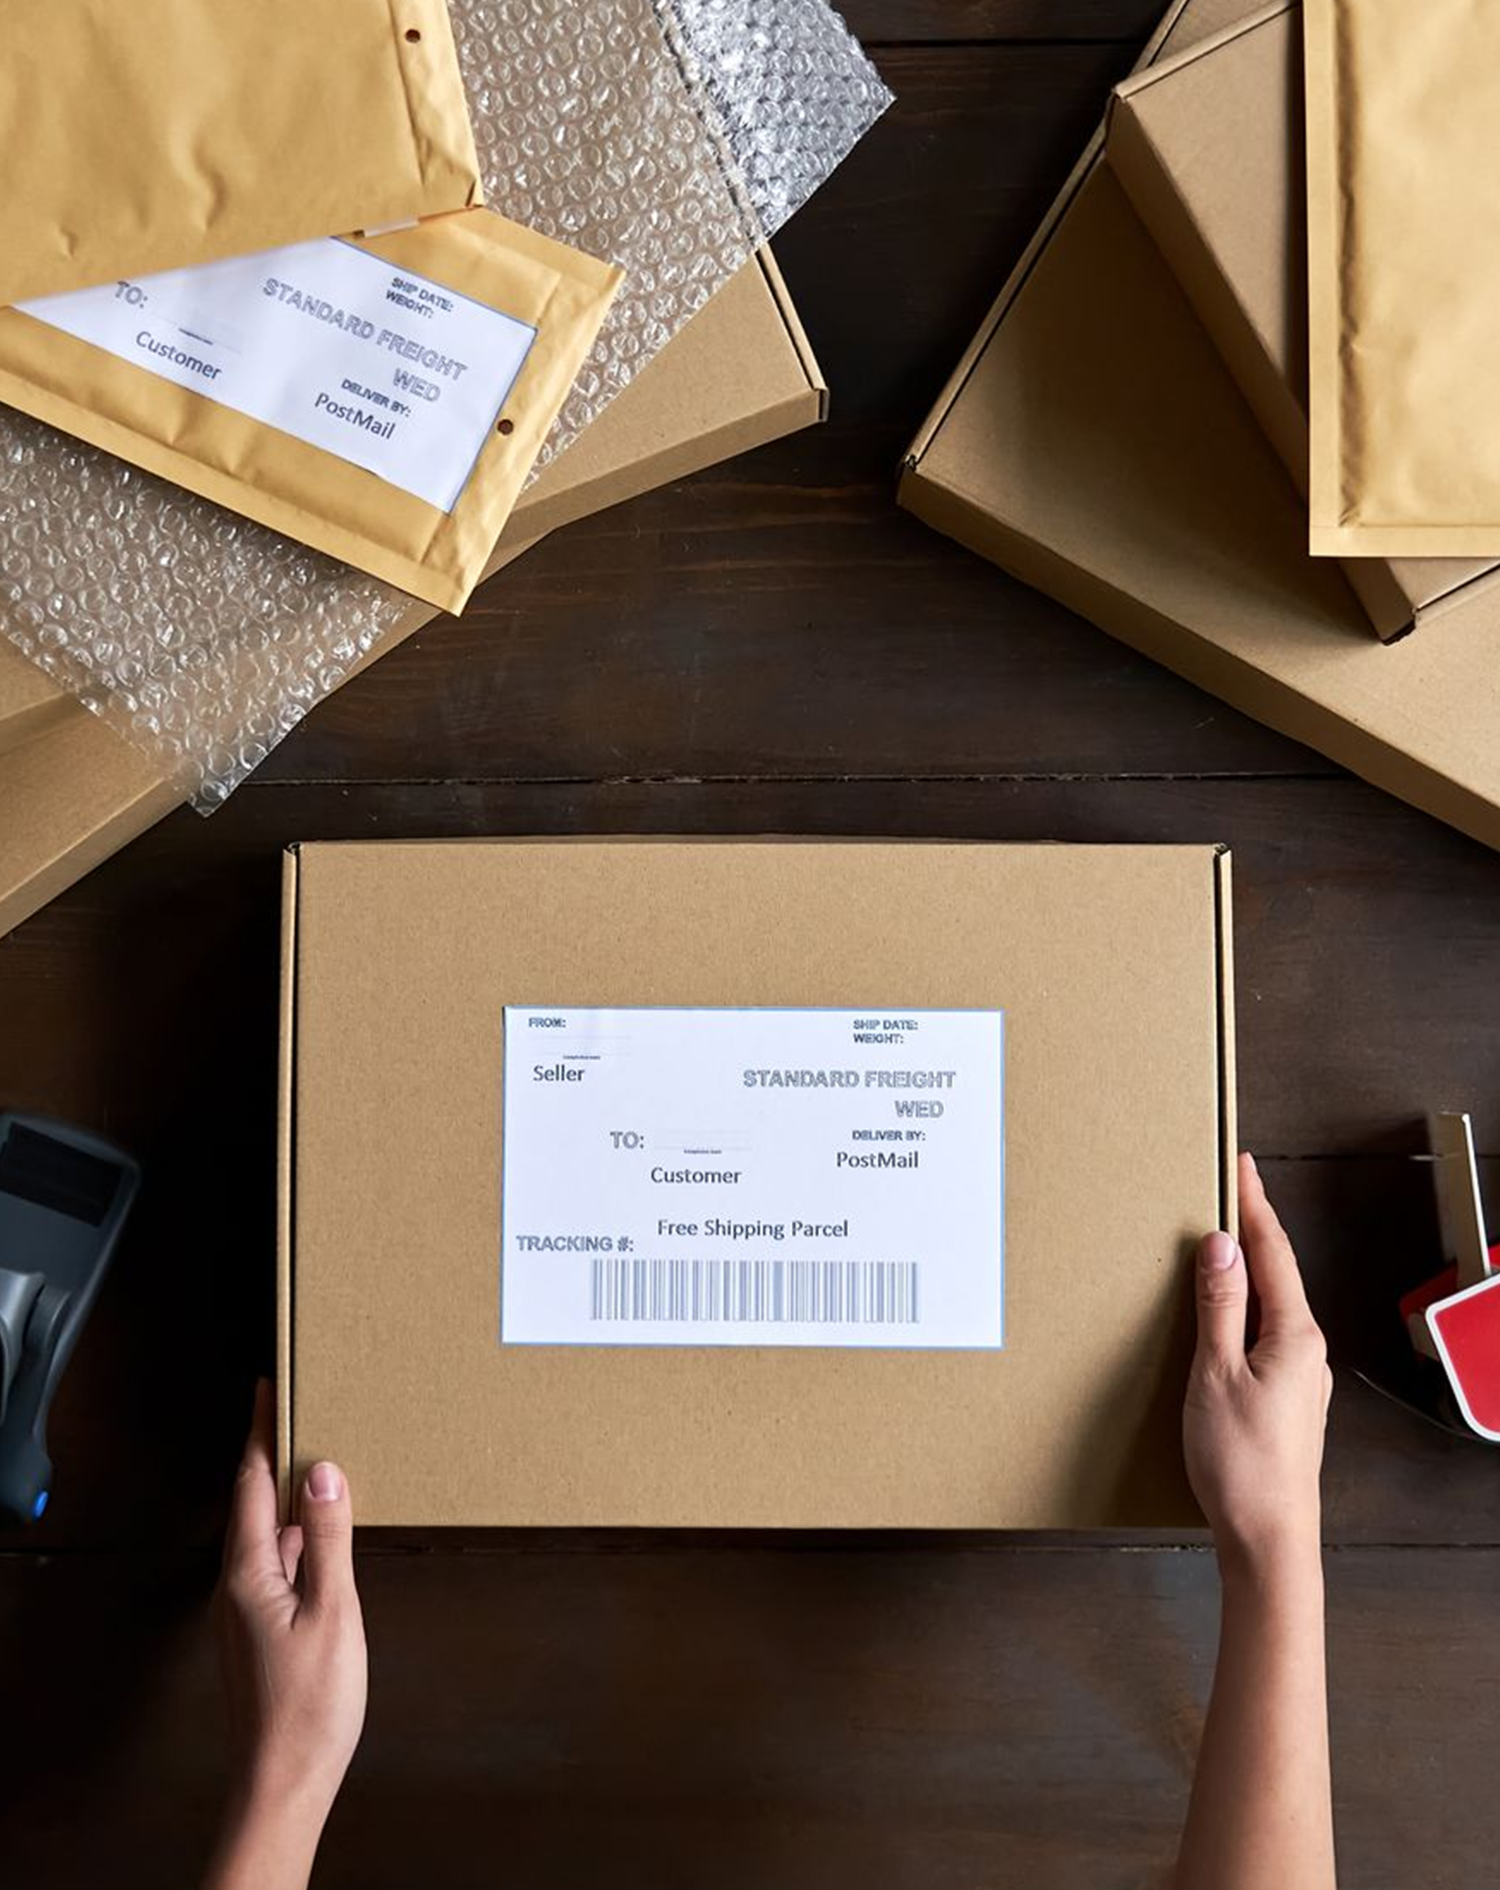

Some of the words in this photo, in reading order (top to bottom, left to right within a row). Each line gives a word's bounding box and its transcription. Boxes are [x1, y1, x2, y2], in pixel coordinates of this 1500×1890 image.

[114, 280, 148, 309] TO:
[386, 289, 434, 319] WEIGHT:
[391, 277, 418, 293] SHIP
[418, 288, 454, 312] DATE:
[262, 278, 375, 340] STANDARD
[376, 329, 467, 381] FREIGHT
[136, 331, 223, 379] Customer
[393, 368, 441, 402] WED
[341, 378, 390, 407] DELIVER
[390, 400, 412, 418] BY:
[314, 392, 396, 440] PostMail
[528, 1017, 567, 1028] FROM:
[853, 1019, 880, 1030] SHIP
[882, 1019, 919, 1030] DATE:
[852, 1033, 904, 1044] WEIGHT:
[532, 1064, 586, 1082] Seller
[743, 1069, 860, 1088] STANDARD
[864, 1070, 957, 1089] FREIGHT
[894, 1100, 945, 1118] WED
[609, 1131, 645, 1150] TO:
[851, 1130, 903, 1141] DELIVER
[905, 1130, 926, 1142] BY:
[836, 1151, 919, 1169] PostMail
[650, 1167, 743, 1184] Customer
[657, 1218, 699, 1237] Free
[704, 1218, 786, 1242] Shipping
[791, 1219, 849, 1238] Parcel
[515, 1235, 613, 1252] TRACKING
[617, 1236, 634, 1253] #:
